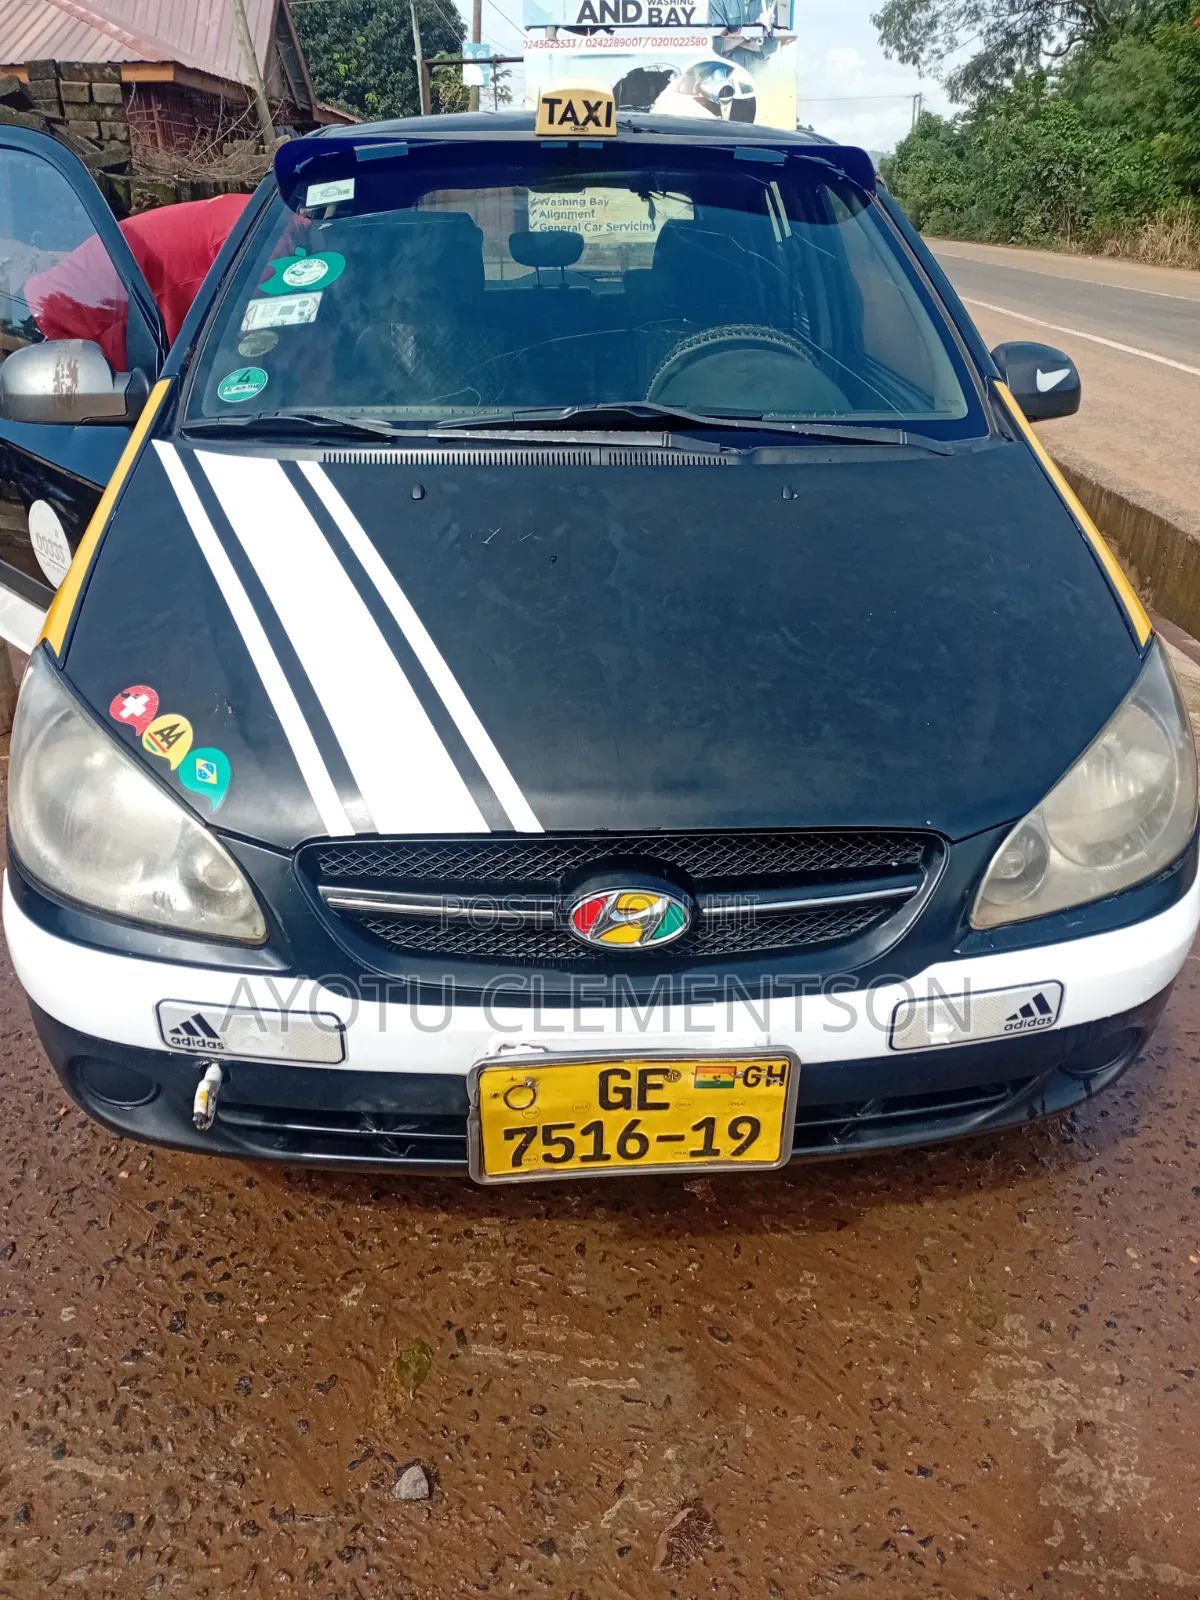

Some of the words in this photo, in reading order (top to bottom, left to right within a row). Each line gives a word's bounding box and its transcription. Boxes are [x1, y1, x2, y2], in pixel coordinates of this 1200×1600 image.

[576, 0, 643, 24] AND
[648, 7, 697, 26] BAY
[585, 37, 643, 48] 0242289001
[651, 36, 708, 47] 0201022580
[541, 97, 613, 128] TAXI
[538, 197, 586, 208] Washing
[589, 197, 610, 208] Bay
[539, 209, 596, 221] Alignment
[539, 222, 581, 233] General
[583, 222, 603, 232] Car
[605, 220, 656, 233] Servicing
[1003, 1016, 1053, 1032] adidas
[170, 1035, 225, 1051] adidas
[743, 1064, 787, 1088] GH
[599, 1067, 671, 1112] GE
[503, 1115, 761, 1168] 7516-19
